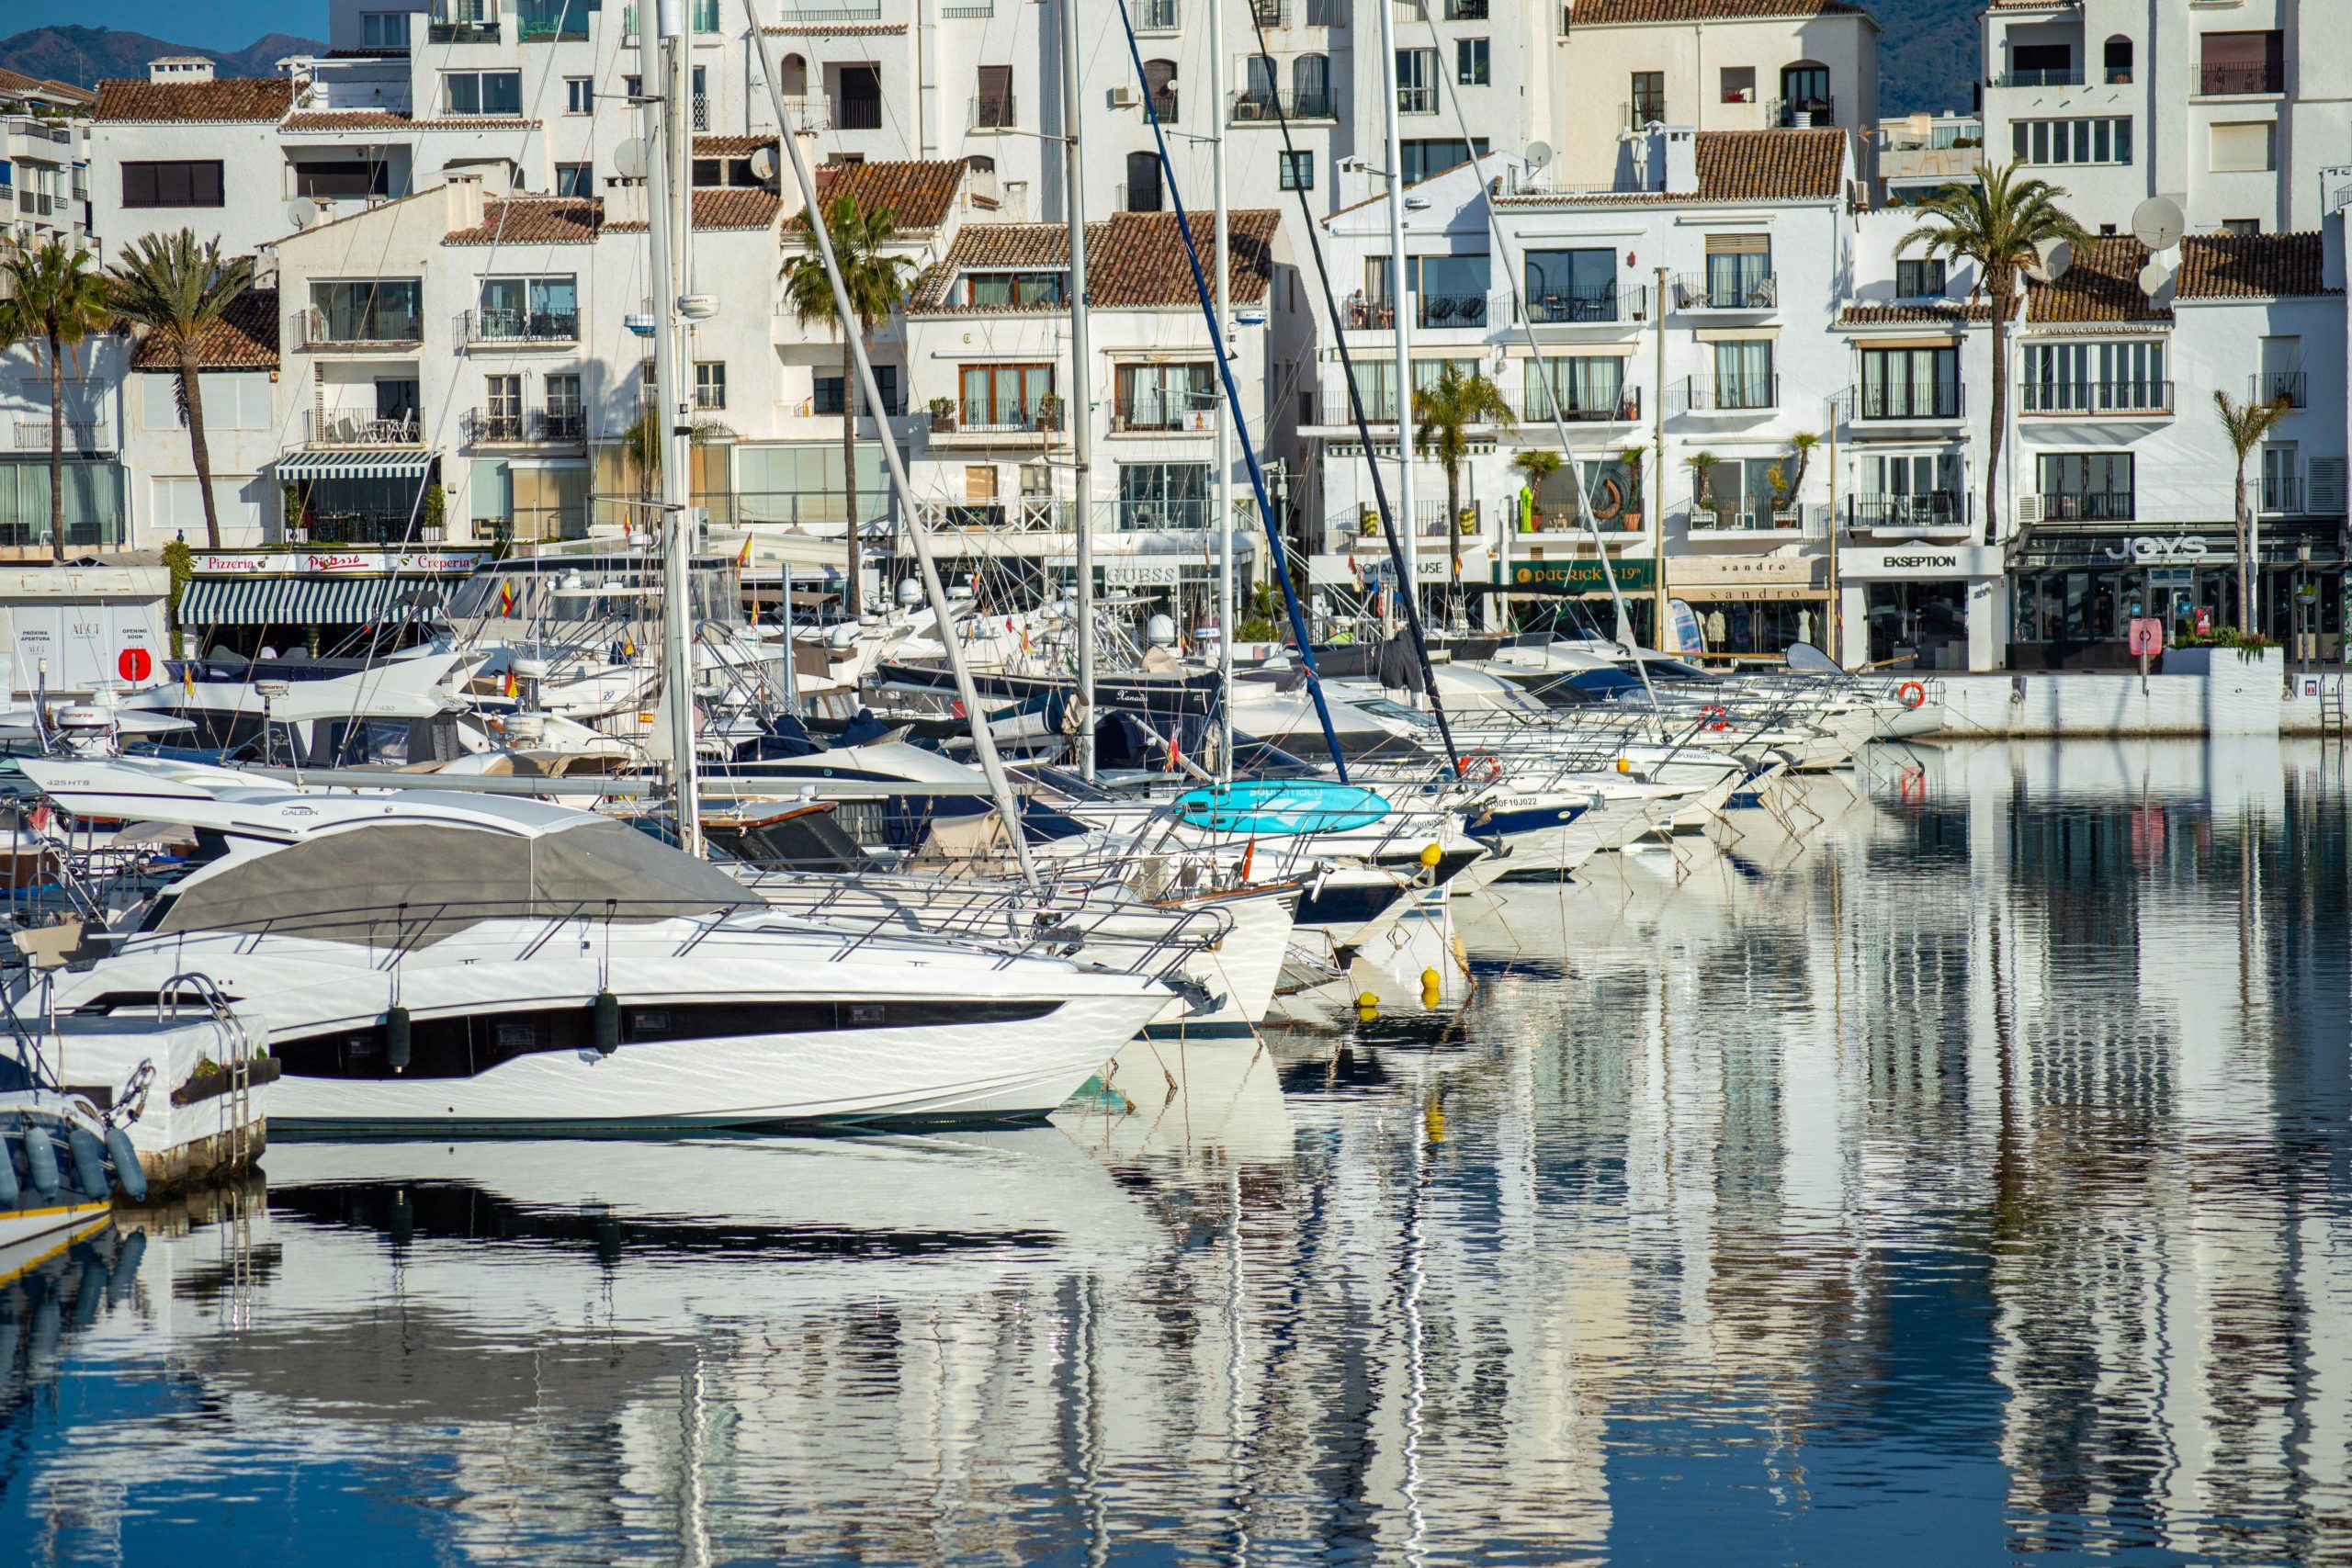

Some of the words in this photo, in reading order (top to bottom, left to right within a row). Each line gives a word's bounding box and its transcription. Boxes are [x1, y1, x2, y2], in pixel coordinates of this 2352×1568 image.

[209, 557, 254, 569] Pizzeria
[1721, 562, 1786, 571] sandro
[1883, 556, 1956, 568] EKSEPTION
[1106, 568, 1175, 583] GUESS
[1710, 589, 1800, 600] sandro
